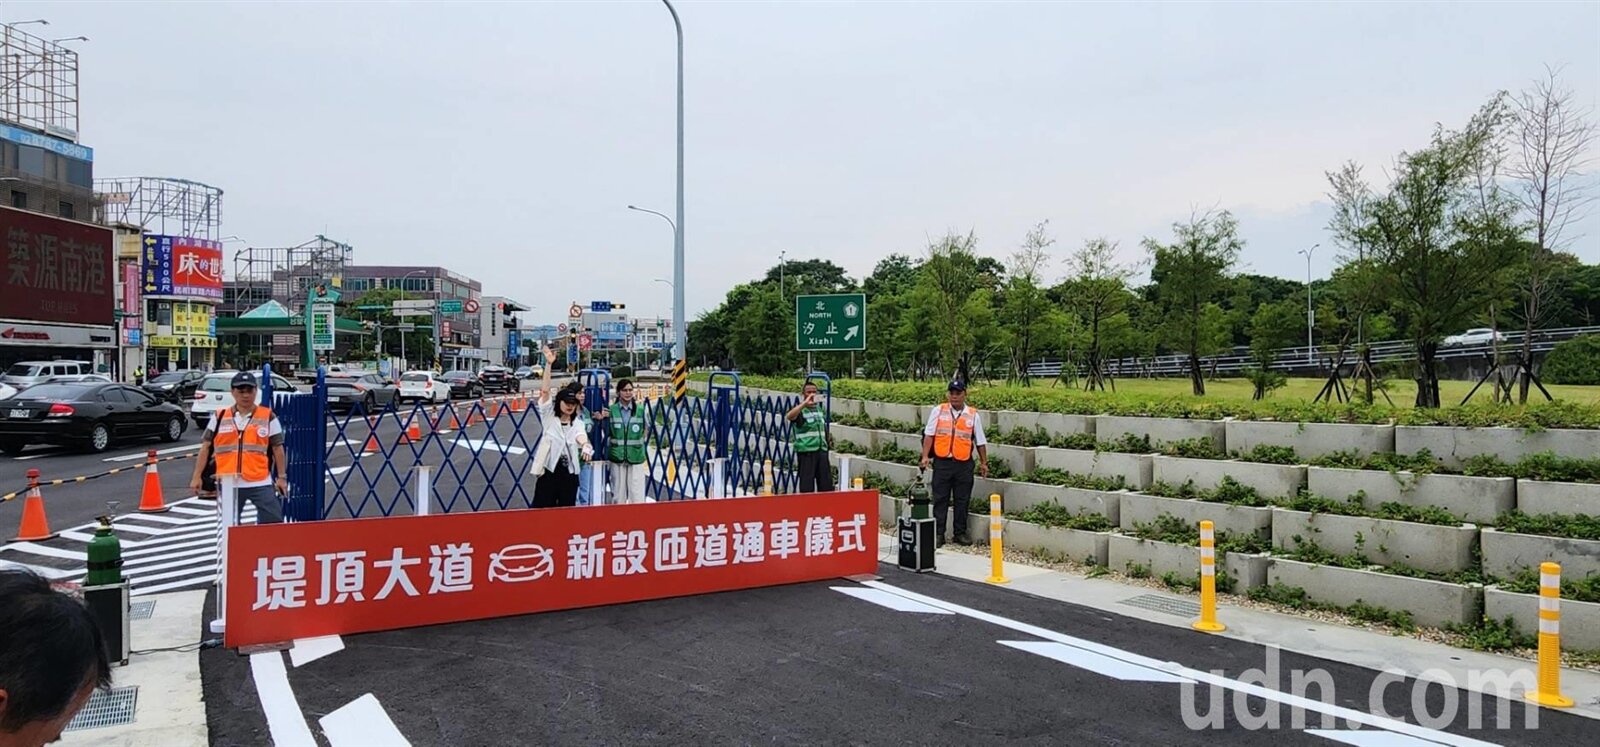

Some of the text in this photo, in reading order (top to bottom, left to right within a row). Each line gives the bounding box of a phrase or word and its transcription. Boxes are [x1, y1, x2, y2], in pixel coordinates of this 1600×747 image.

[8, 226, 105, 296] 築源南港
[176, 252, 222, 280] 床的世
[815, 301, 825, 311] 北
[803, 322, 839, 335] 汐止
[809, 337, 833, 345] Xizhi
[252, 513, 867, 611] 堤頂大道 新設匝道通車儀式
